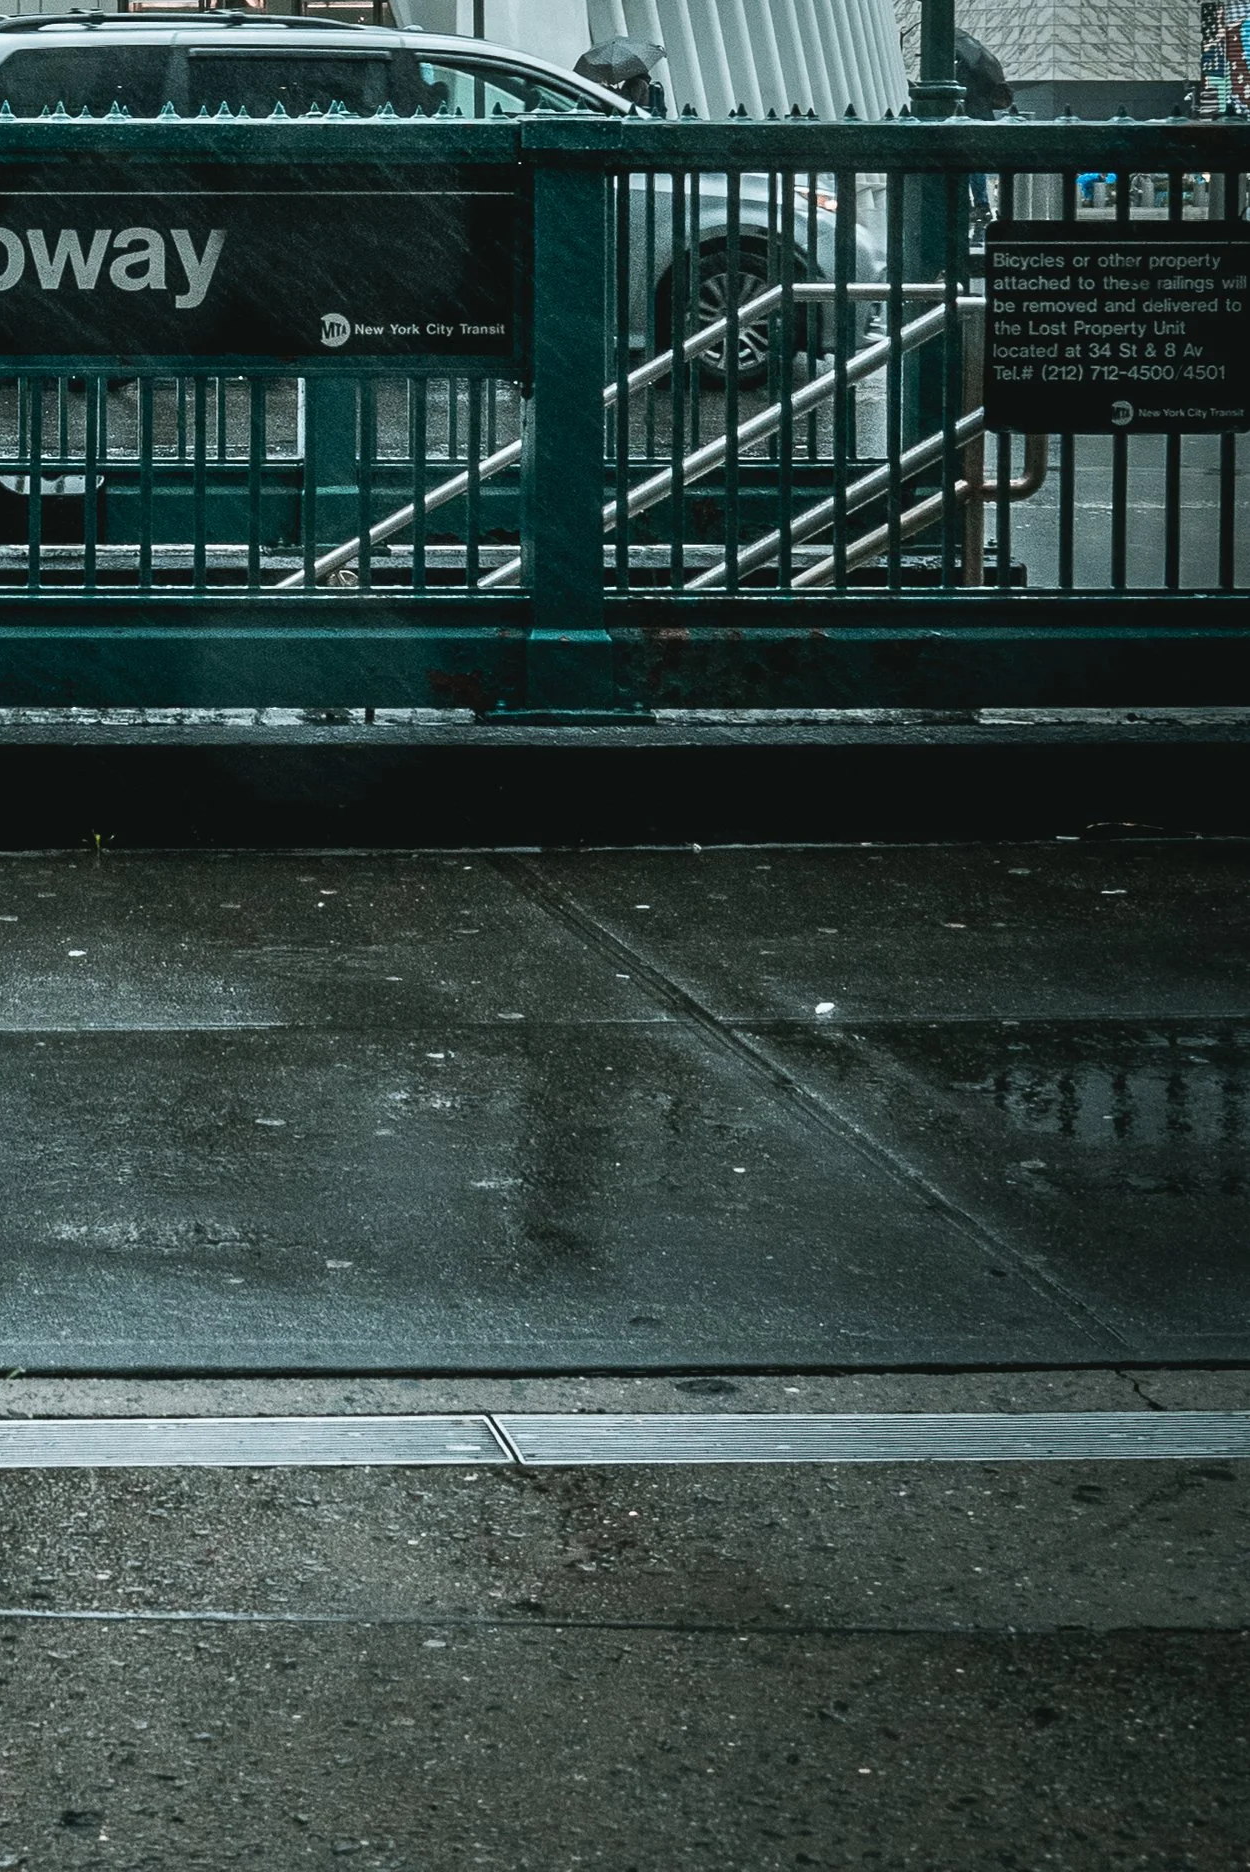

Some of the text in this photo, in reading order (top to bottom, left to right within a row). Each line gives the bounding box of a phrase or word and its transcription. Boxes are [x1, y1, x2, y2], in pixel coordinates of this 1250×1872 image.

[993, 252, 1222, 270] Bicycles or other property
[993, 275, 1247, 294] attached to these railings will
[993, 297, 1242, 313] be removed and delivered to
[321, 318, 349, 342] MTA
[354, 323, 506, 338] New York City Transit
[994, 320, 1186, 339] the Lost Property Unit
[993, 342, 1203, 358] located at 34 St & 8 Av
[992, 364, 1227, 382] Tel.# (212) 712-4500/4501
[1138, 407, 1245, 420] New York City Transit
